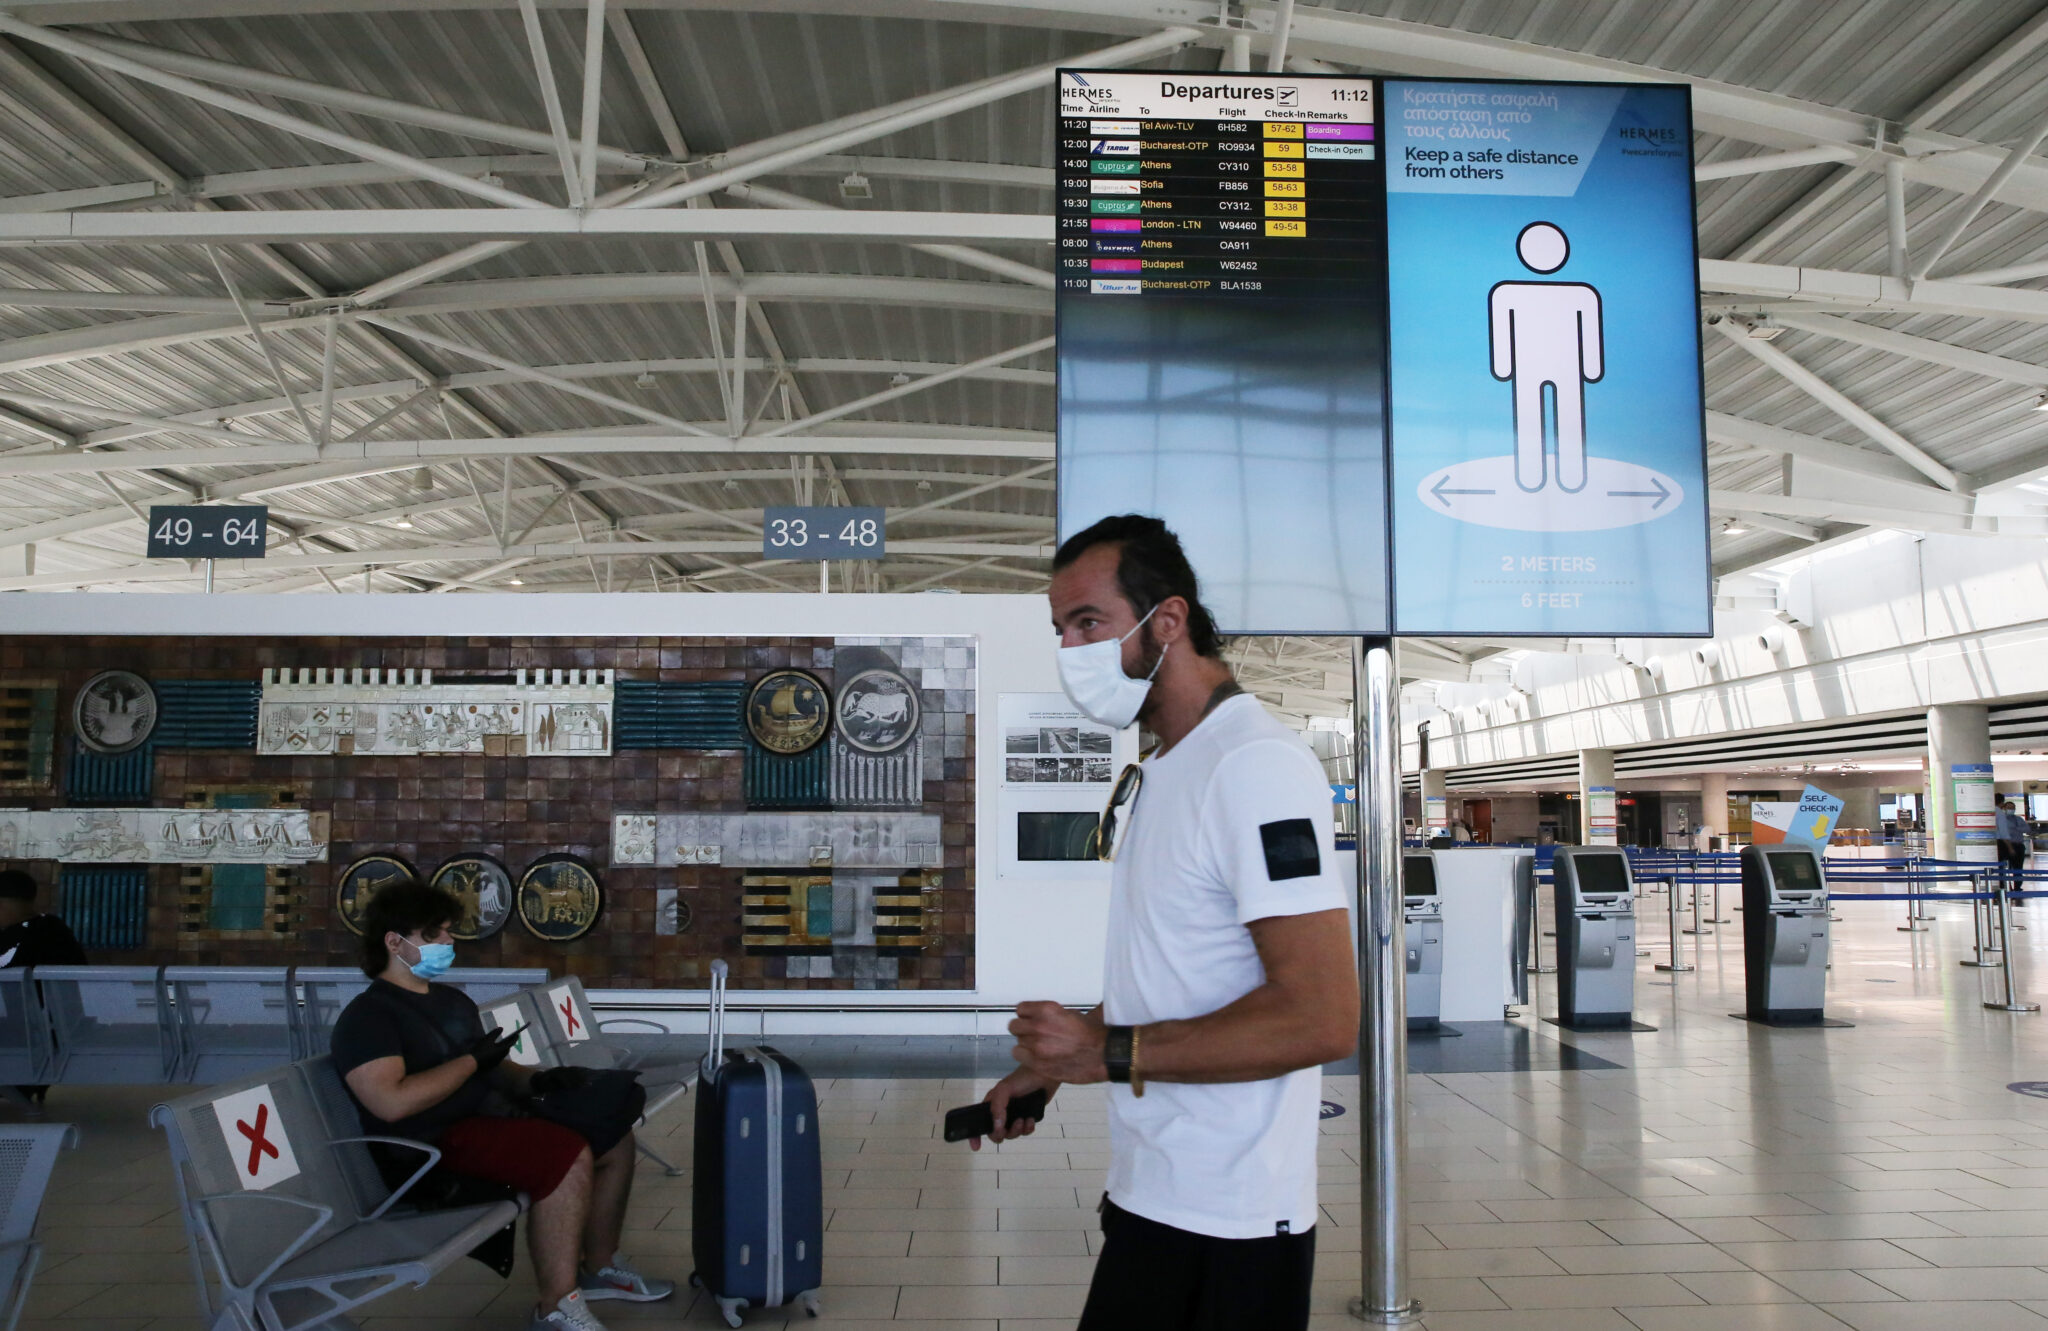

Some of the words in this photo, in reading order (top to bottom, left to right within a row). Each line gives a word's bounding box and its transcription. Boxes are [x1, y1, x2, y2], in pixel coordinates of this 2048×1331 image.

[1062, 88, 1112, 103] HERMES
[1161, 81, 1275, 103] Departures
[1331, 89, 1369, 102] 11:12
[1403, 88, 1487, 108] Κρατήστε
[1491, 91, 1558, 112] ασφαλή
[1061, 104, 1084, 113] Time
[1089, 105, 1120, 113] Airline
[1139, 107, 1152, 115] To
[1219, 108, 1246, 117] Flight
[1264, 109, 1306, 119] Check-In
[1307, 111, 1348, 120] Remarks
[1403, 106, 1492, 127] απόσταση
[1497, 107, 1532, 124] από
[1063, 120, 1088, 129] 11:20
[1140, 121, 1153, 130] Tel
[1154, 122, 1195, 131] Aviv-TLV
[1217, 123, 1248, 132] 6H582
[1271, 125, 1296, 133] 57-62
[1308, 126, 1341, 135] Boarding
[1403, 125, 1445, 141] τους
[1448, 122, 1511, 142] άλλους
[1620, 128, 1676, 144] HERMES
[1063, 139, 1088, 149] 12:00
[1140, 141, 1209, 151] Bucharest-OTP
[1218, 142, 1255, 151] RO9934
[1278, 144, 1290, 152] 59
[1308, 145, 1341, 153] Check-in
[1342, 146, 1363, 155] Open
[1405, 146, 1449, 165] Keep
[1453, 151, 1464, 162] a
[1467, 148, 1502, 163] safe
[1506, 149, 1579, 165] distance
[1063, 160, 1088, 168] 14:00
[1097, 162, 1126, 170] Cyprus
[1140, 161, 1172, 170] Athens
[1218, 162, 1250, 171] CY310
[1272, 164, 1297, 172] 53-58
[1405, 163, 1446, 178] from
[1450, 165, 1504, 179] others
[1063, 179, 1088, 188] 19:00
[1140, 180, 1164, 189] Sofia
[1218, 182, 1249, 190] FB856
[1272, 183, 1298, 191] 58-63
[1063, 199, 1088, 208] 19:30
[1097, 202, 1126, 210] Cyprus
[1140, 200, 1172, 209] Athens
[1273, 203, 1298, 211] 33-38
[1062, 219, 1088, 228] 21:55
[1141, 220, 1175, 229] London
[1183, 221, 1201, 230] LTN
[1219, 221, 1257, 230] W94460
[1273, 223, 1298, 231] 49-54
[1062, 239, 1088, 248] 08:00
[1140, 240, 1173, 249] Athens
[1219, 241, 1250, 250] OA911
[1063, 259, 1088, 268] 10:35
[1141, 260, 1184, 270] Budapest
[1220, 261, 1258, 270] W62452
[1063, 279, 1088, 288] 11:00
[1141, 280, 1211, 290] Bucharest-OTP
[1220, 281, 1262, 290] BLA1538
[154, 518, 193, 546] 49
[222, 518, 259, 546] 64
[770, 518, 809, 547] 33
[838, 518, 878, 547] 48
[1501, 556, 1514, 572] 2
[1520, 556, 1597, 572] METERS
[1521, 592, 1533, 608] 6
[1537, 593, 1583, 609] FEET
[1804, 794, 1828, 802] SELF
